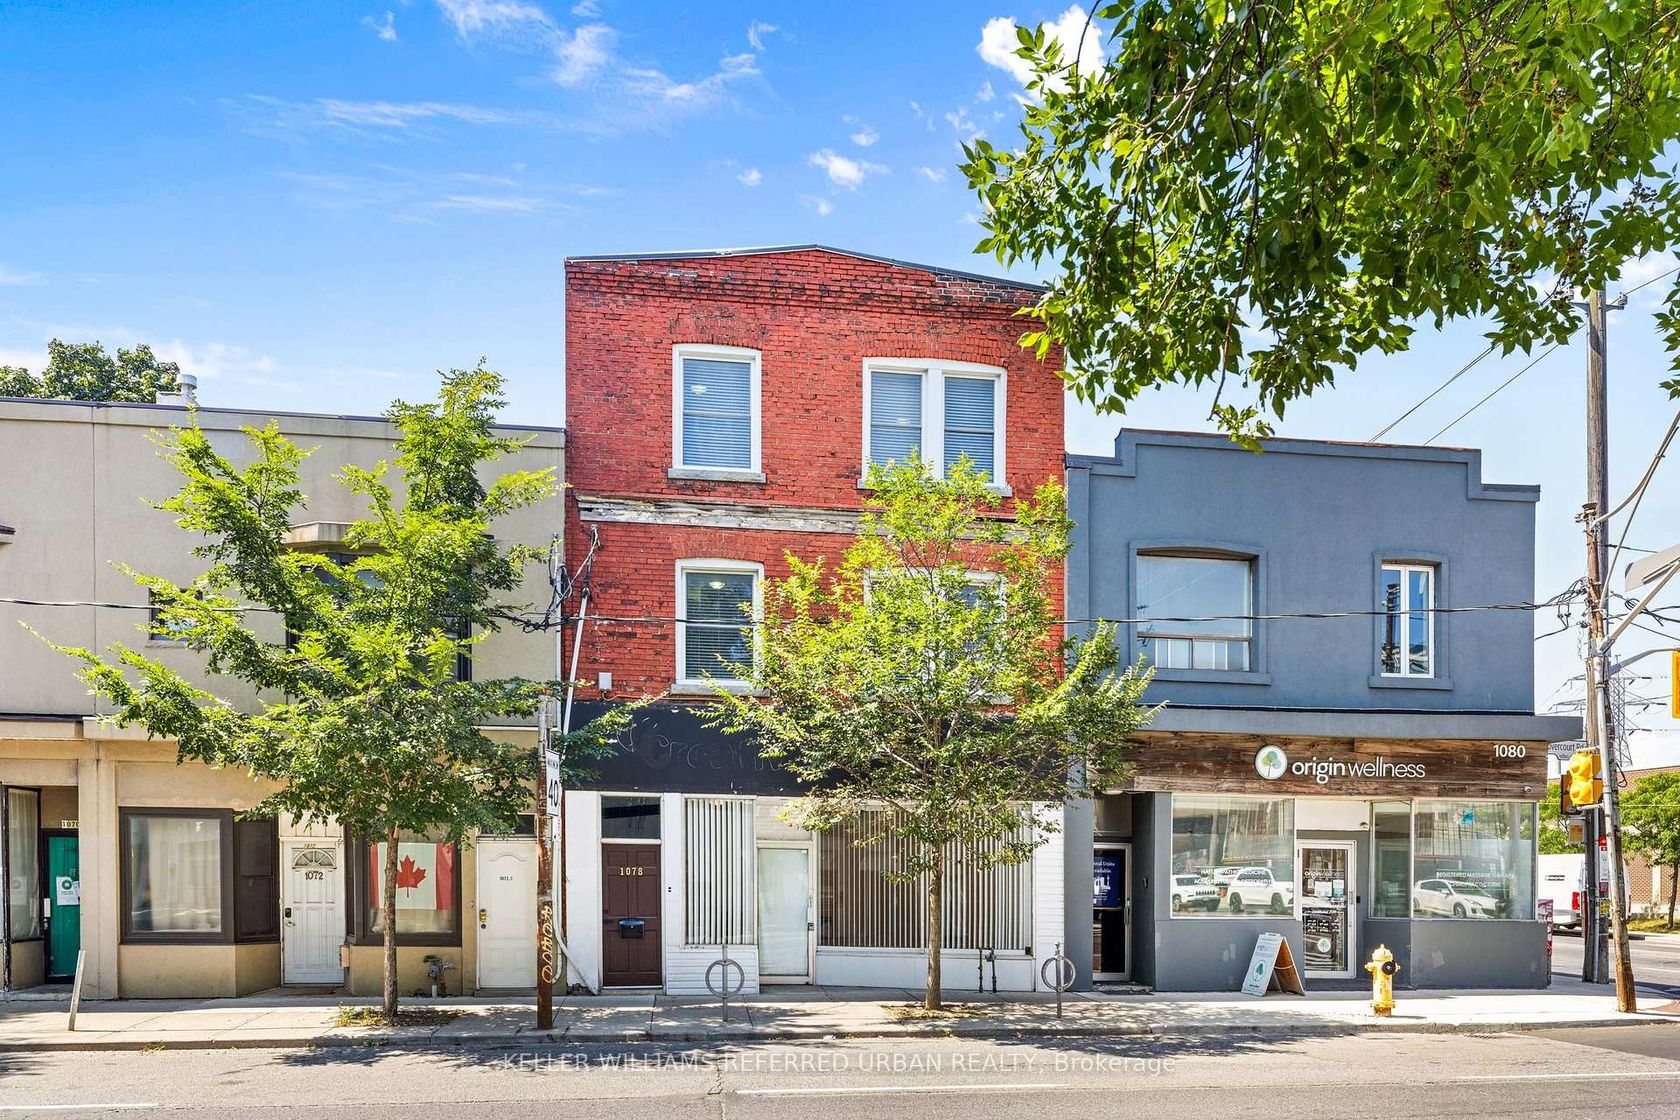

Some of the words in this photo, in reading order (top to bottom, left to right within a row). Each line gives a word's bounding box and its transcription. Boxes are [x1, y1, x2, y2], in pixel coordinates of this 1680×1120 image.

[1493, 744, 1526, 758] 1080
[1550, 743, 1575, 751] vercourt
[1291, 756, 1345, 784] origin
[1347, 756, 1426, 778] wellness
[548, 779, 559, 807] 40
[305, 870, 324, 880] 1072
[620, 867, 644, 876] 1078
